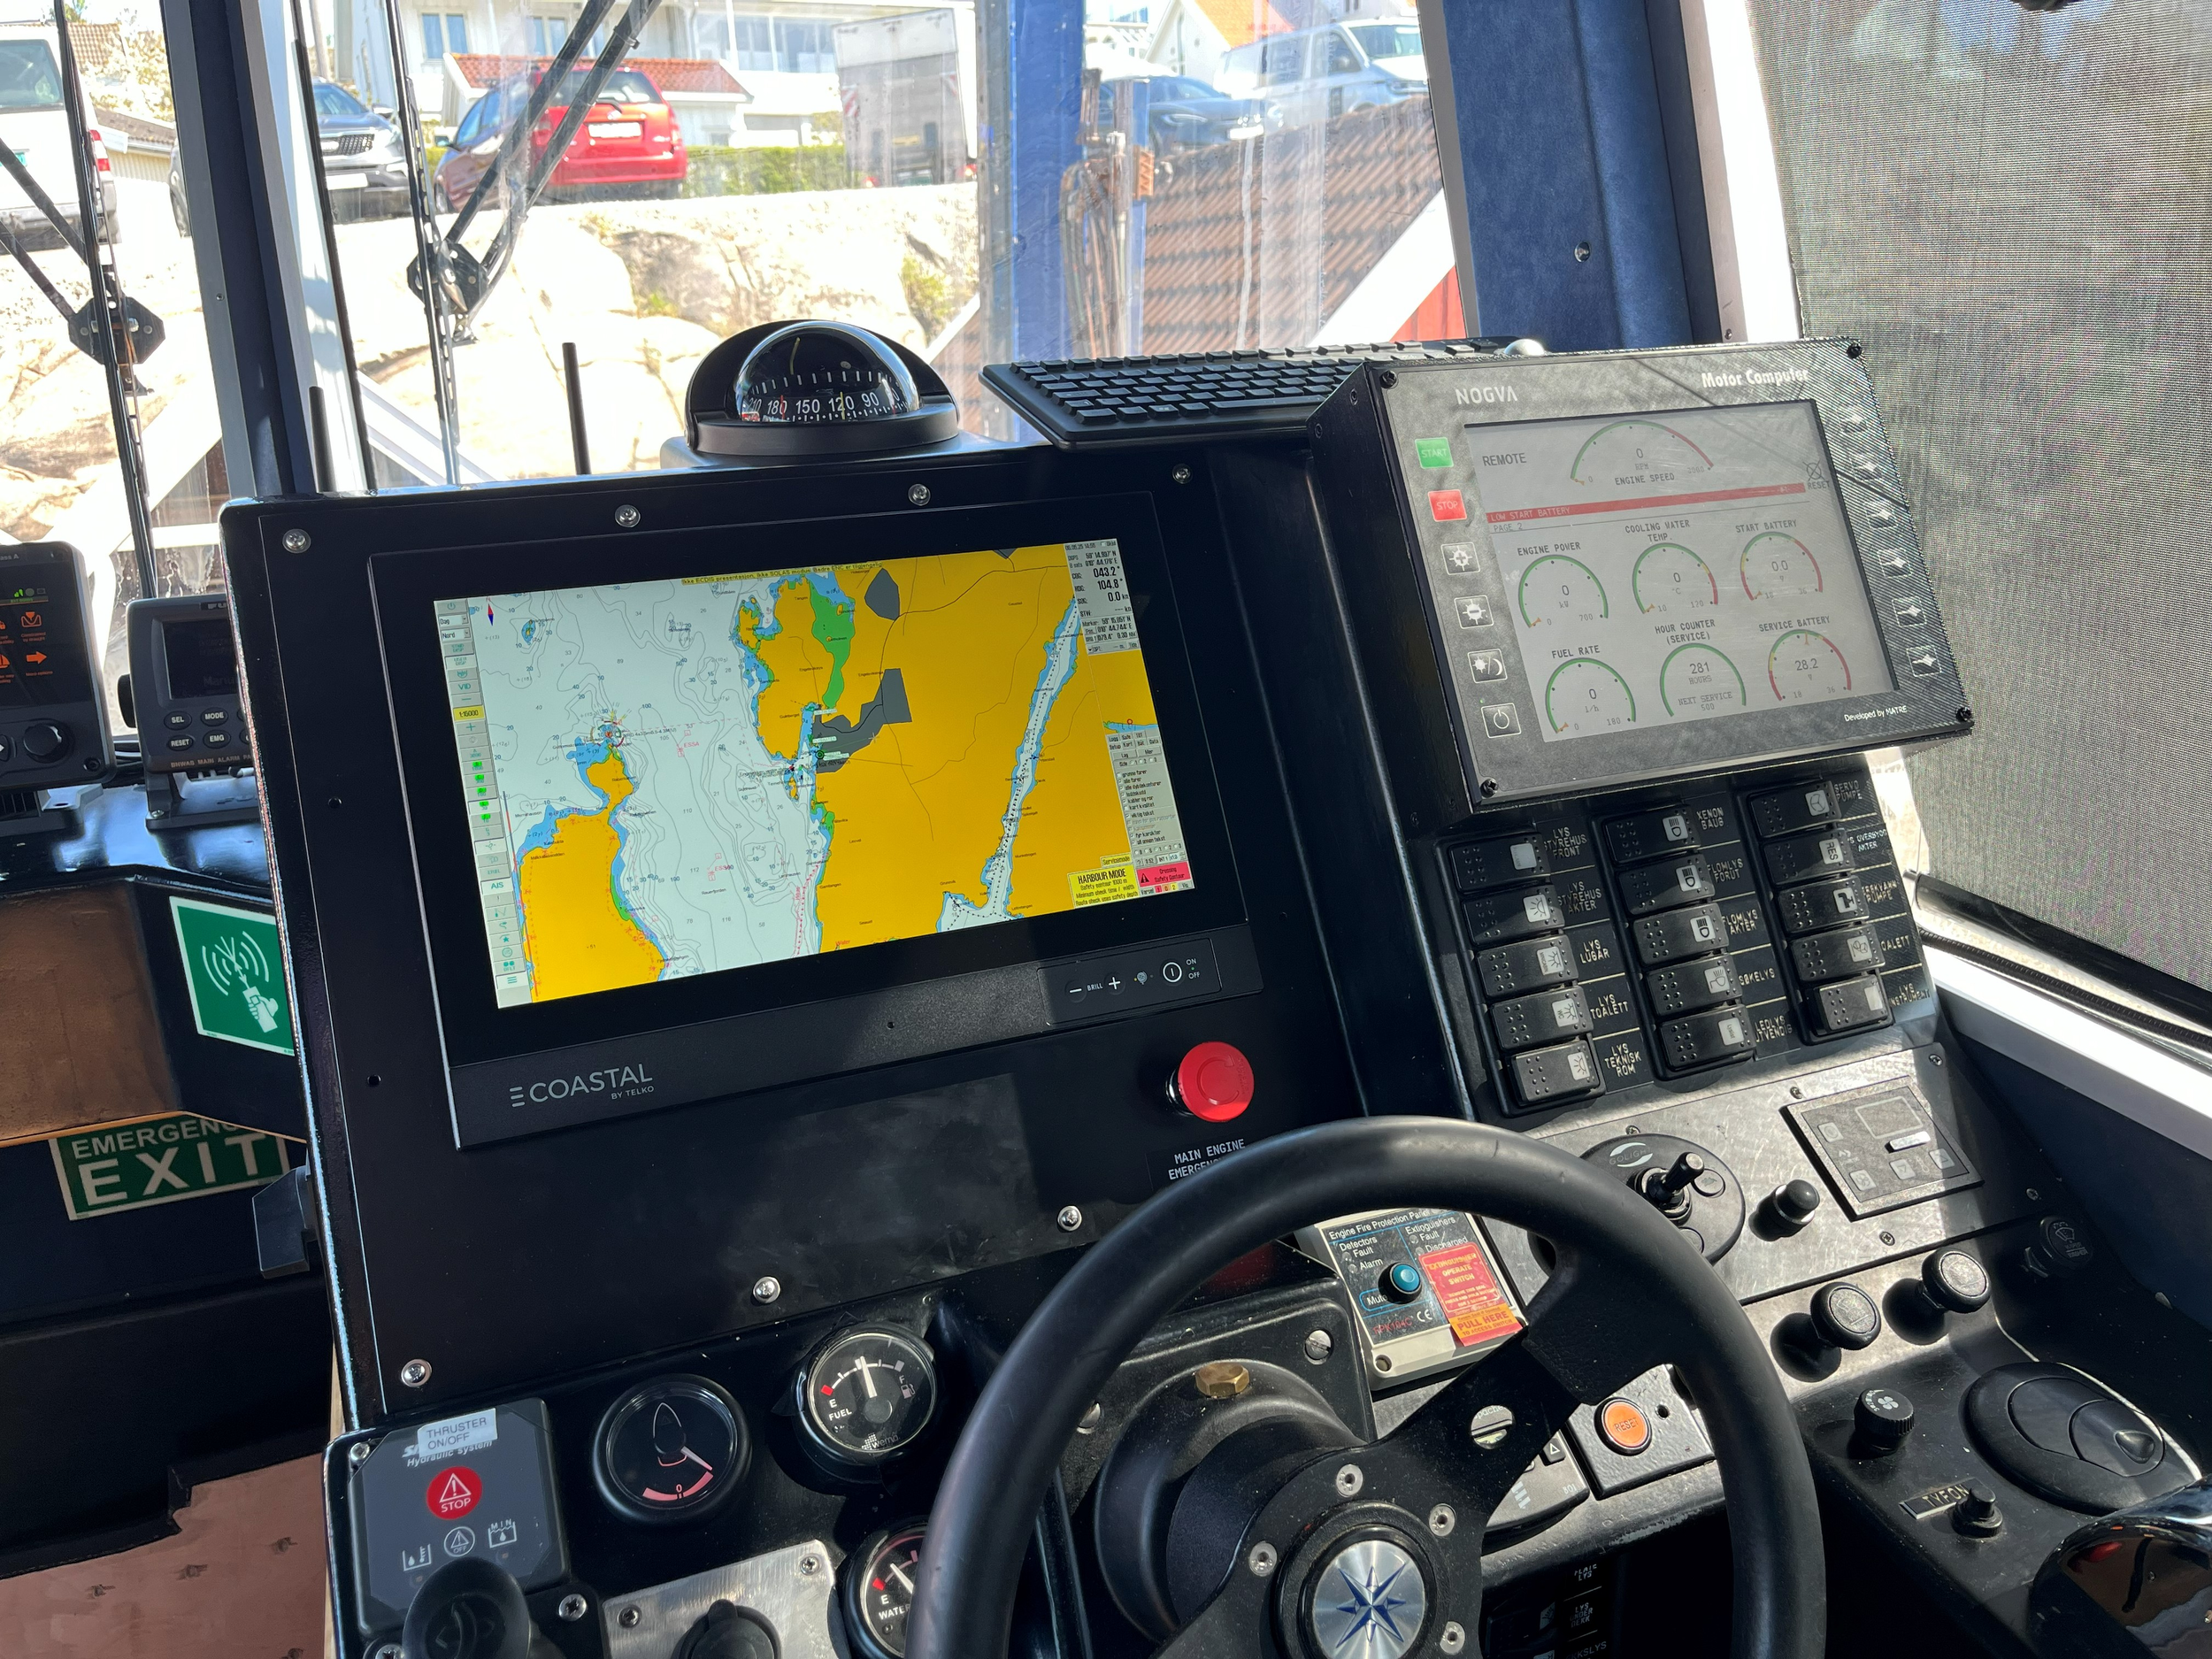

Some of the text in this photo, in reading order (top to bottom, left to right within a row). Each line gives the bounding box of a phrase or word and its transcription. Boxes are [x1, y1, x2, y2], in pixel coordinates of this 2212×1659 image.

[1701, 368, 1809, 388] Motor Computer
[862, 391, 879, 407] 90
[1455, 385, 1518, 405] NOGVA
[767, 400, 787, 414] 180
[795, 399, 821, 414] 150
[828, 395, 855, 412] 120
[1421, 448, 1448, 458] START
[1482, 452, 1527, 467] REMOTE
[1636, 448, 1644, 459] 0
[1615, 472, 1675, 486] ENGINE SPEED
[1436, 501, 1458, 511] STOP
[1490, 506, 1571, 522] LOW START BATTERY
[1494, 522, 1524, 533] PAGE 2
[1624, 518, 1690, 534] COOLING WATER
[1736, 518, 1797, 534] START BATTERY
[1517, 541, 1582, 557] ENGINE POWER
[1771, 559, 1788, 572] 0.0
[1673, 572, 1681, 584] 0
[1108, 591, 1121, 602] 0.0
[1562, 584, 1570, 596] 0
[1690, 600, 1704, 609] 120
[1578, 613, 1593, 622] 700
[1759, 616, 1831, 633] SERVICE BATTERY
[1655, 619, 1717, 634] HOUR COUNTER
[1665, 630, 1711, 646] (SERVICE)
[1552, 644, 1601, 660] FUEL RATE
[1689, 662, 1710, 674] 281
[1794, 657, 1819, 672] 28.2
[1688, 674, 1713, 686] HOURS
[1589, 688, 1597, 700] 0
[1678, 691, 1732, 706] NEXT SERVICE
[204, 711, 225, 720] MODE
[1844, 704, 1908, 723] Developed by MATRE
[1607, 717, 1621, 726] 180
[170, 738, 189, 747] RESET
[209, 734, 225, 743] EMG
[218, 755, 241, 764] ALARM
[1833, 780, 1860, 794] SERVO
[1835, 789, 1863, 803] PUMPE
[1696, 807, 1724, 821] XENON
[1552, 826, 1571, 839] LYS
[1552, 846, 1580, 858] FRONT
[1824, 841, 1839, 861] RES
[1078, 868, 1127, 885] HARBOUR MODE
[1715, 869, 1741, 883] FORUT
[490, 881, 504, 890] AIS
[1568, 881, 1586, 894] LYS
[1557, 888, 1602, 906] STYREHUS
[1568, 900, 1597, 915] AKTER
[1730, 918, 1757, 935] AKTER
[1583, 939, 1601, 952] LYS
[1880, 934, 1911, 952] OALETT
[1186, 957, 1198, 966] ON
[1579, 949, 1610, 964] LUGAR
[1187, 972, 1201, 980] OFF
[1738, 968, 1776, 986] SØKELYS
[1087, 982, 1103, 992] BRILL
[1598, 993, 1616, 1007] LYS
[1589, 1001, 1630, 1020] TOALETT
[1754, 1015, 1786, 1032] LEDLYS
[1610, 1042, 1630, 1057] LYS
[1604, 1051, 1642, 1069] TEKNISK
[1616, 1063, 1637, 1078] ROM
[611, 1085, 655, 1101] BY TELKO
[71, 1118, 239, 1160] EMERGEN
[1173, 1138, 1246, 1164] MAIN ENGINE
[1609, 1147, 1651, 1165] GOLIGHT
[78, 1133, 266, 1207] EXIT
[1168, 1157, 1224, 1180] EMERGEN
[1329, 1226, 1356, 1240] Engine
[1356, 1223, 1371, 1233] Fire
[1371, 1214, 1409, 1229] Protection
[1404, 1216, 1456, 1235] Extinguishers
[1419, 1230, 1440, 1241] Fault
[1339, 1235, 1379, 1252] Detectors
[1353, 1247, 1374, 1258] Fault
[1359, 1258, 1384, 1271] Alarm
[1441, 1263, 1473, 1278] OPERATE
[1448, 1272, 1476, 1285] SWITCH
[1456, 1317, 1483, 1331] PULL
[1483, 1310, 1509, 1325] HERE
[899, 1375, 905, 1384] F
[828, 1398, 837, 1409] E
[828, 1409, 853, 1421] FUEL
[426, 1417, 487, 1438] THRUSTER
[1614, 1417, 1639, 1433] RESET
[427, 1432, 471, 1451] ON/OFF
[457, 1440, 493, 1456] system
[1563, 1483, 1577, 1494] 801
[1922, 1483, 1970, 1508] TYFON
[441, 1497, 472, 1513] STOP
[490, 1518, 512, 1531] MIN
[1578, 1570, 1593, 1582] LYS
[880, 1594, 890, 1605] E
[878, 1603, 910, 1620] WATER
